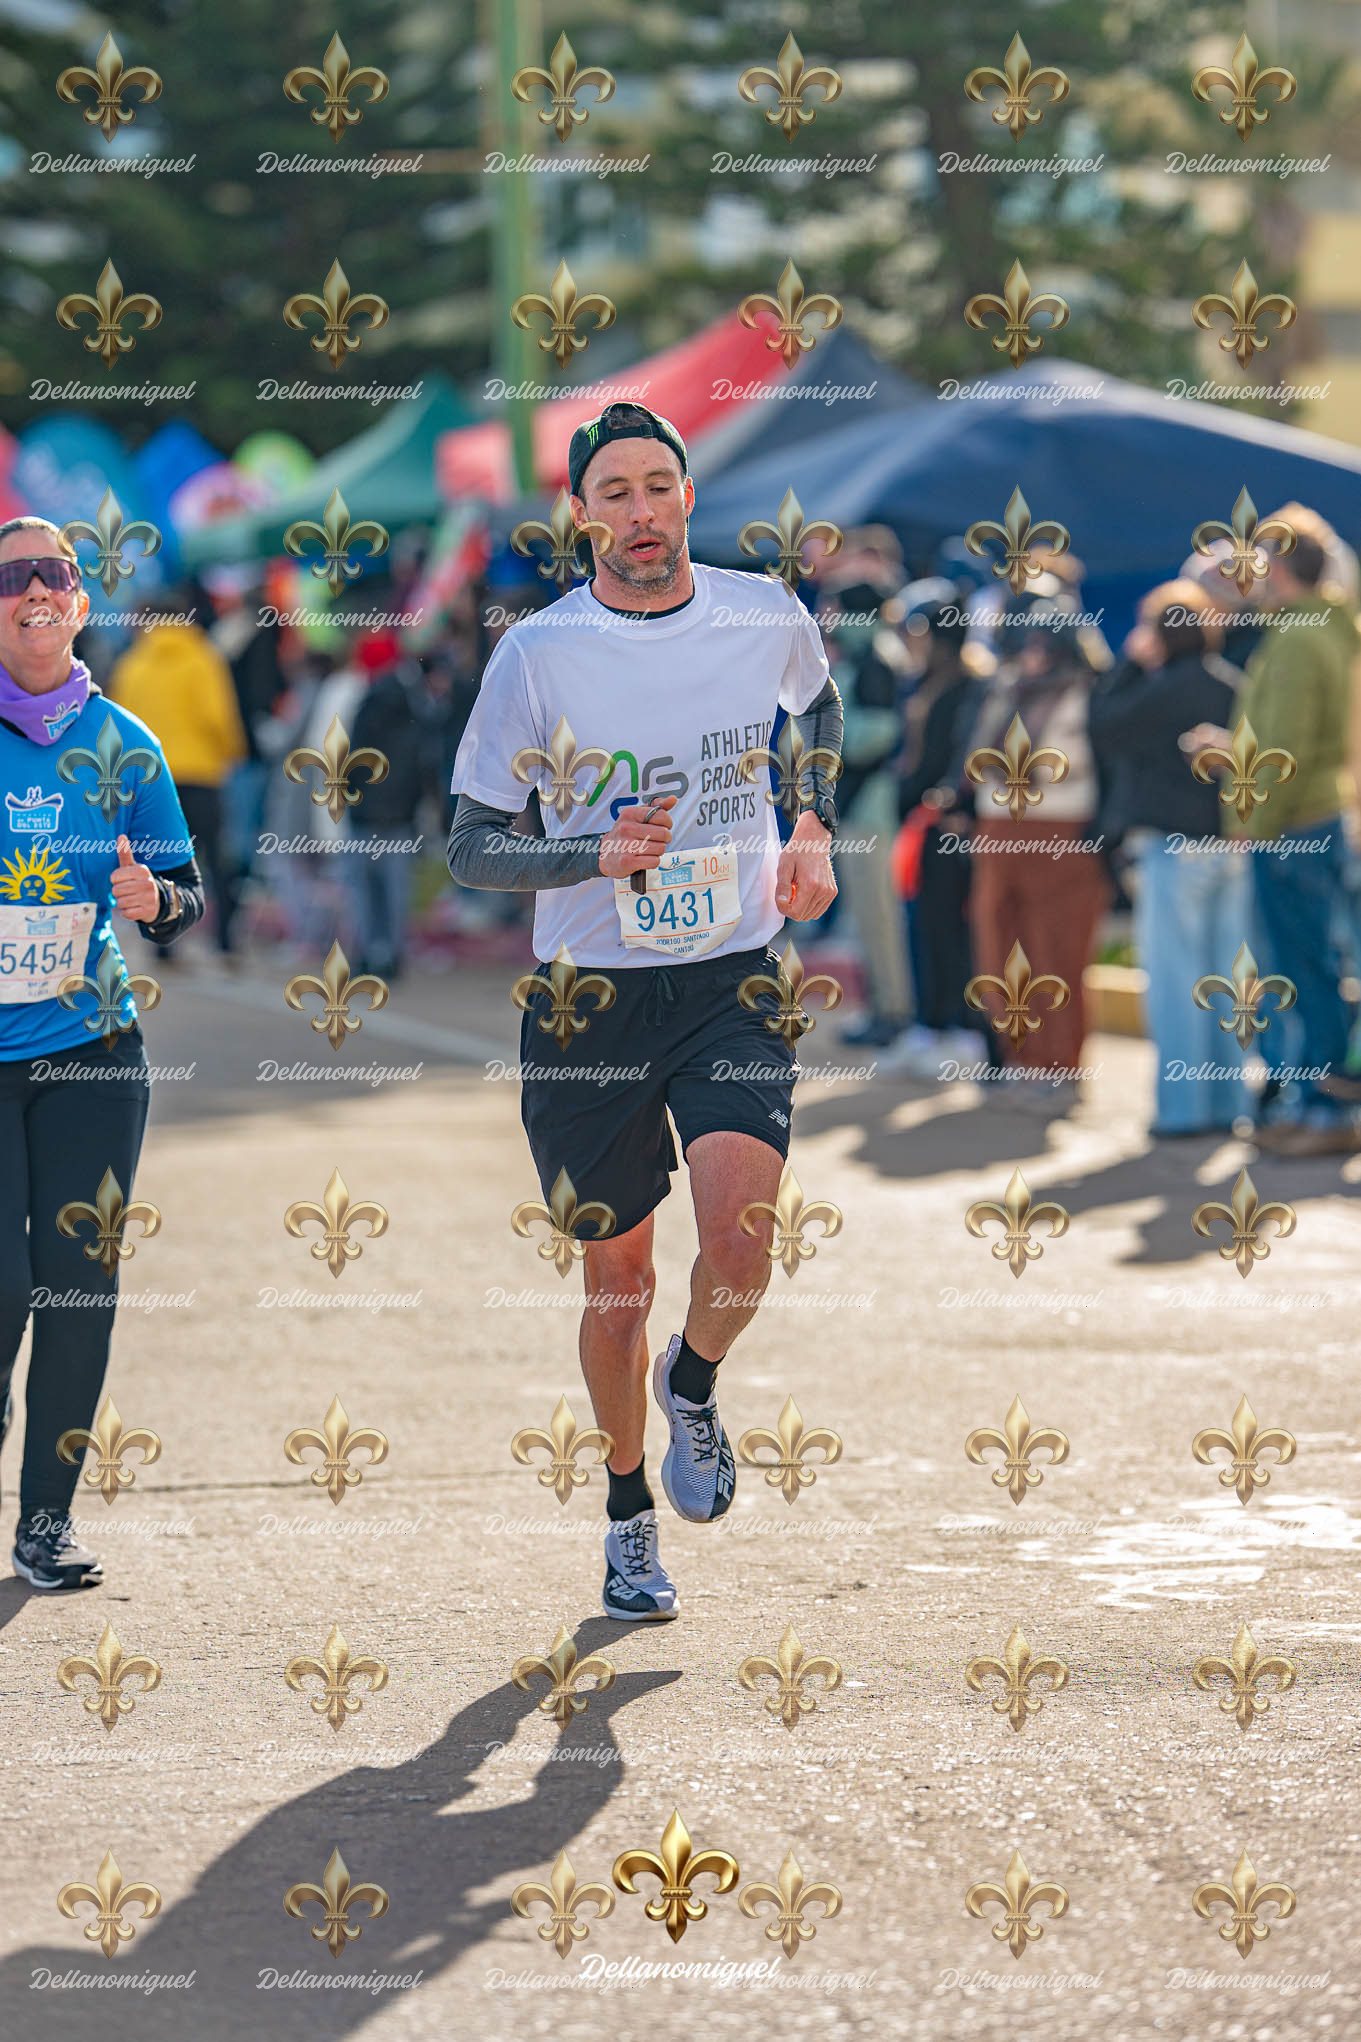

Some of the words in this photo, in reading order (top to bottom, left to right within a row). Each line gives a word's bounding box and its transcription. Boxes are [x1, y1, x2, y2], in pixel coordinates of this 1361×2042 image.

[701, 720, 772, 761] ATHLETIC
[702, 759, 754, 794] GROUP
[697, 792, 756, 826] SPORTS
[635, 887, 715, 932] 9431
[0, 940, 73, 975] 5454
[607, 1574, 641, 1601] FILA
